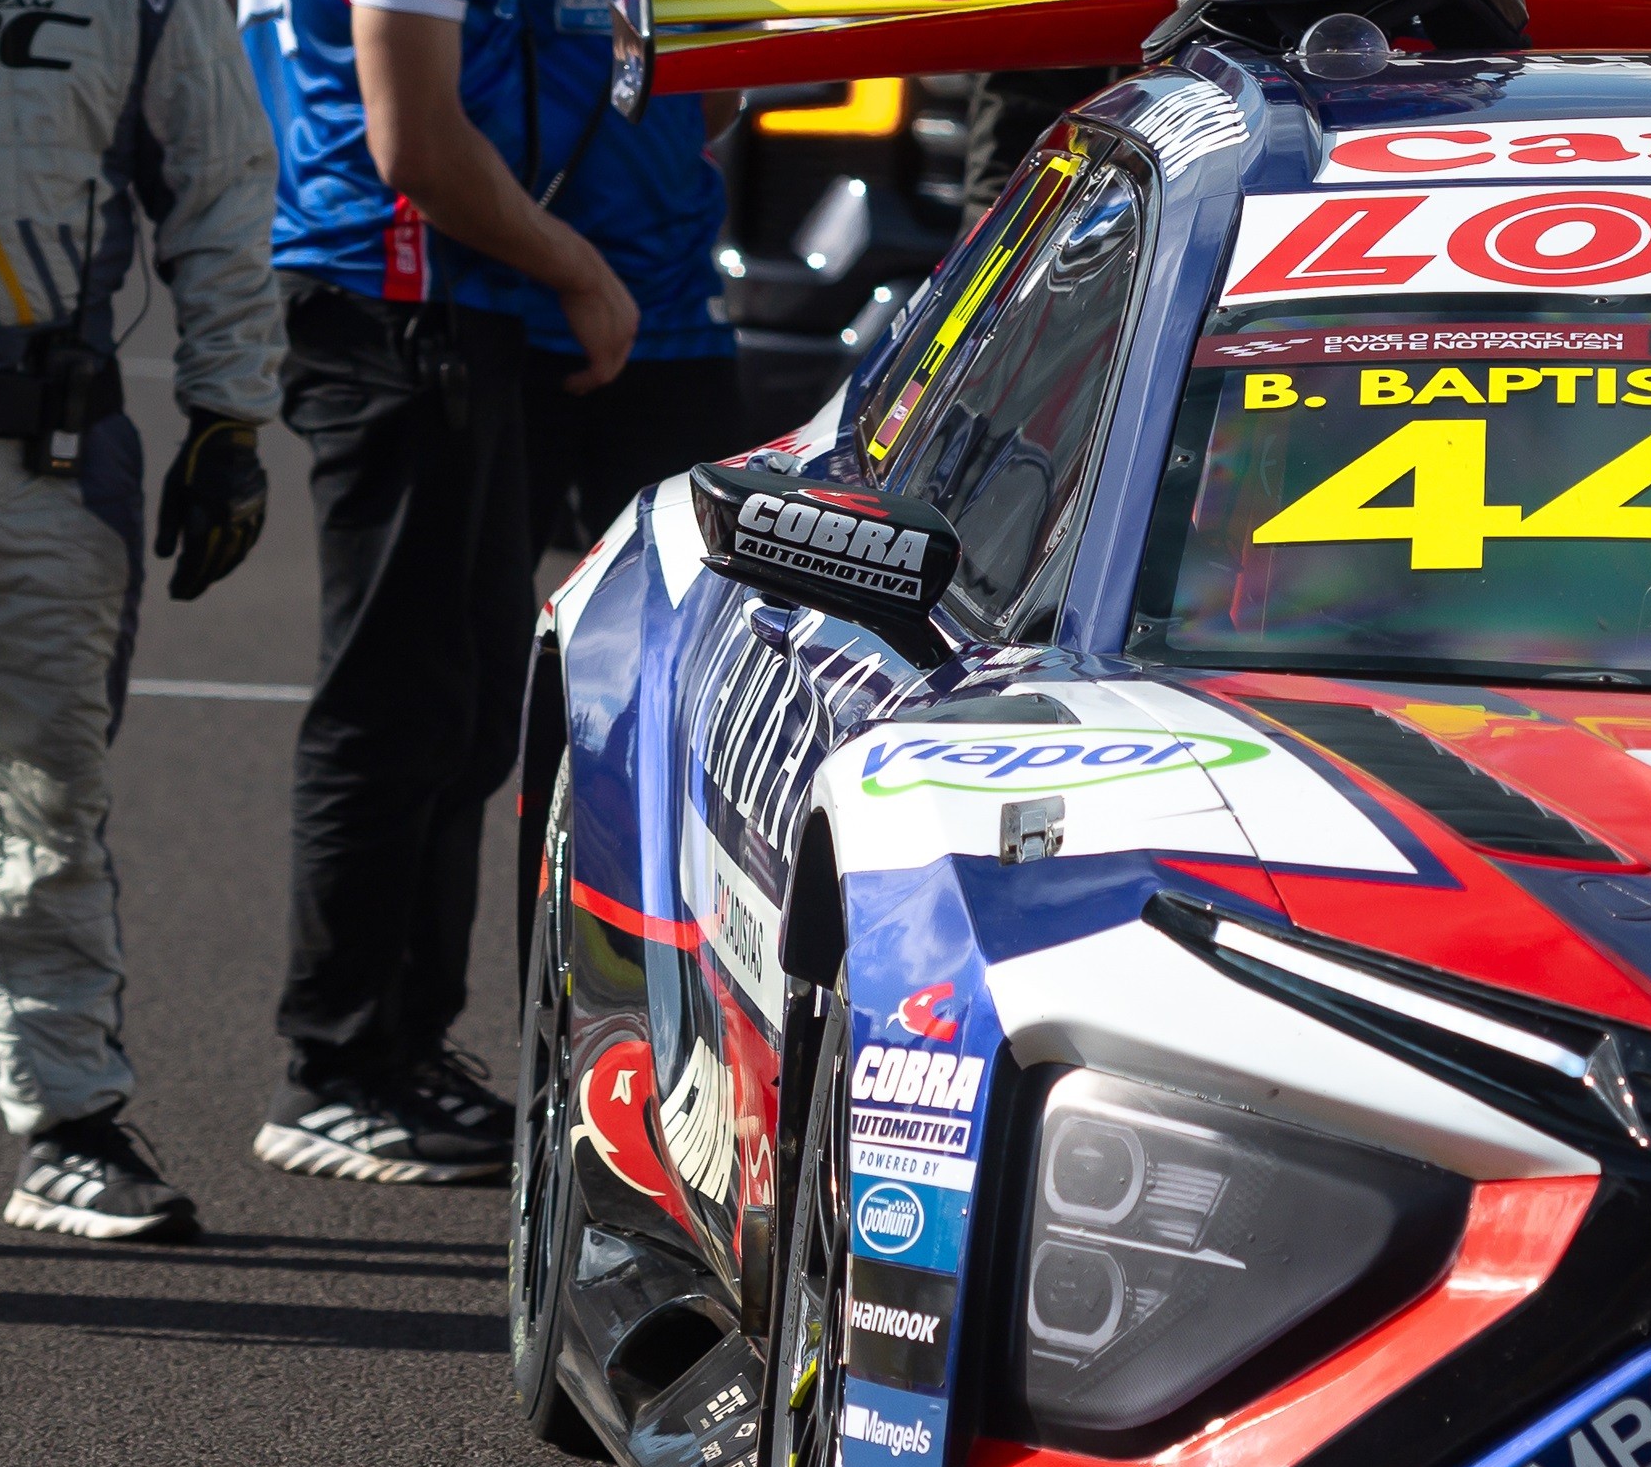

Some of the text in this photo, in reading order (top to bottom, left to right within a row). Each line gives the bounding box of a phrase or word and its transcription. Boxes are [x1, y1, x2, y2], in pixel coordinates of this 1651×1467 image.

[1324, 331, 1624, 345] BAIXE O PADDOCK FAN
[1324, 340, 1625, 354] E VOTE NO FANPUSH
[1242, 373, 1328, 412] B.
[736, 491, 930, 573] COBRA
[738, 535, 922, 600] AUTOMOTIVA
[850, 1043, 988, 1114] COBRA
[858, 1148, 942, 1178] POWERED BY
[864, 1203, 916, 1240] podium
[861, 1407, 933, 1458] Mangels
